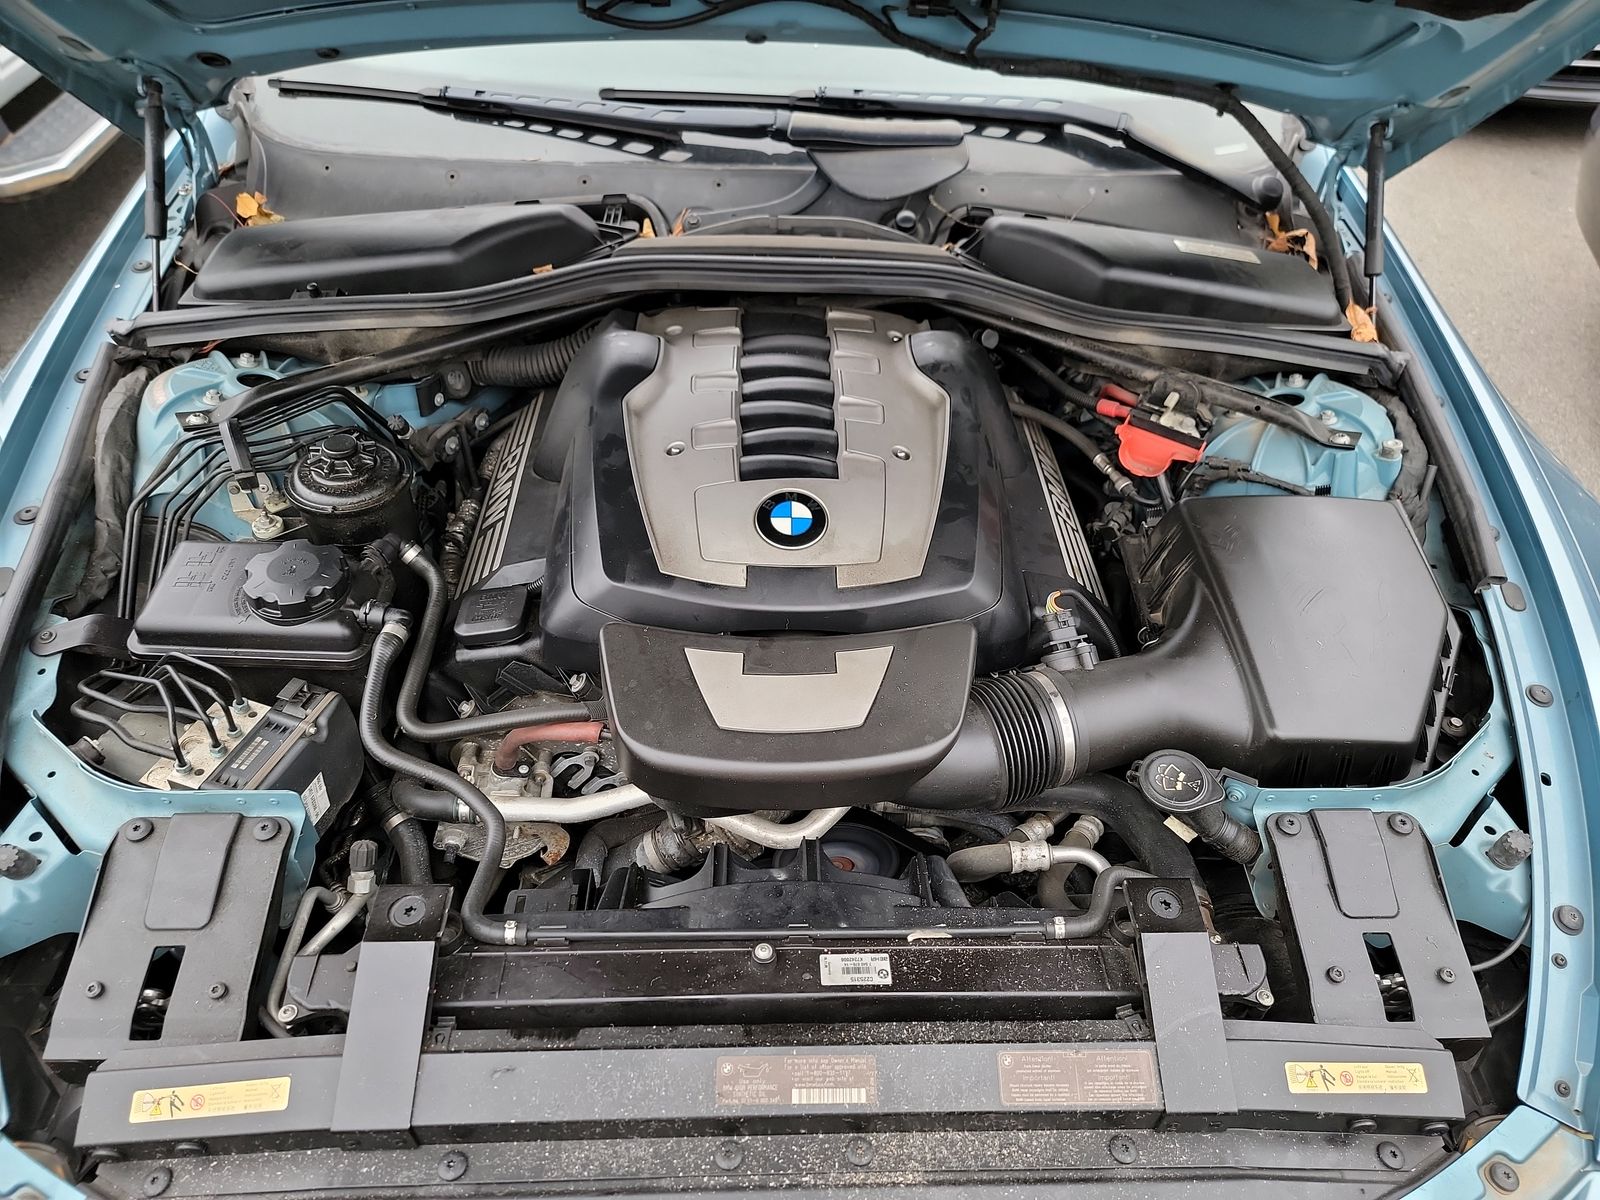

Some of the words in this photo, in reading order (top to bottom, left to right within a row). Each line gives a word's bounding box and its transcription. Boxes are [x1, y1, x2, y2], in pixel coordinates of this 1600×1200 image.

[482, 443, 524, 530] BMW
[763, 492, 821, 511] BMW
[1034, 442, 1077, 531] BMW
